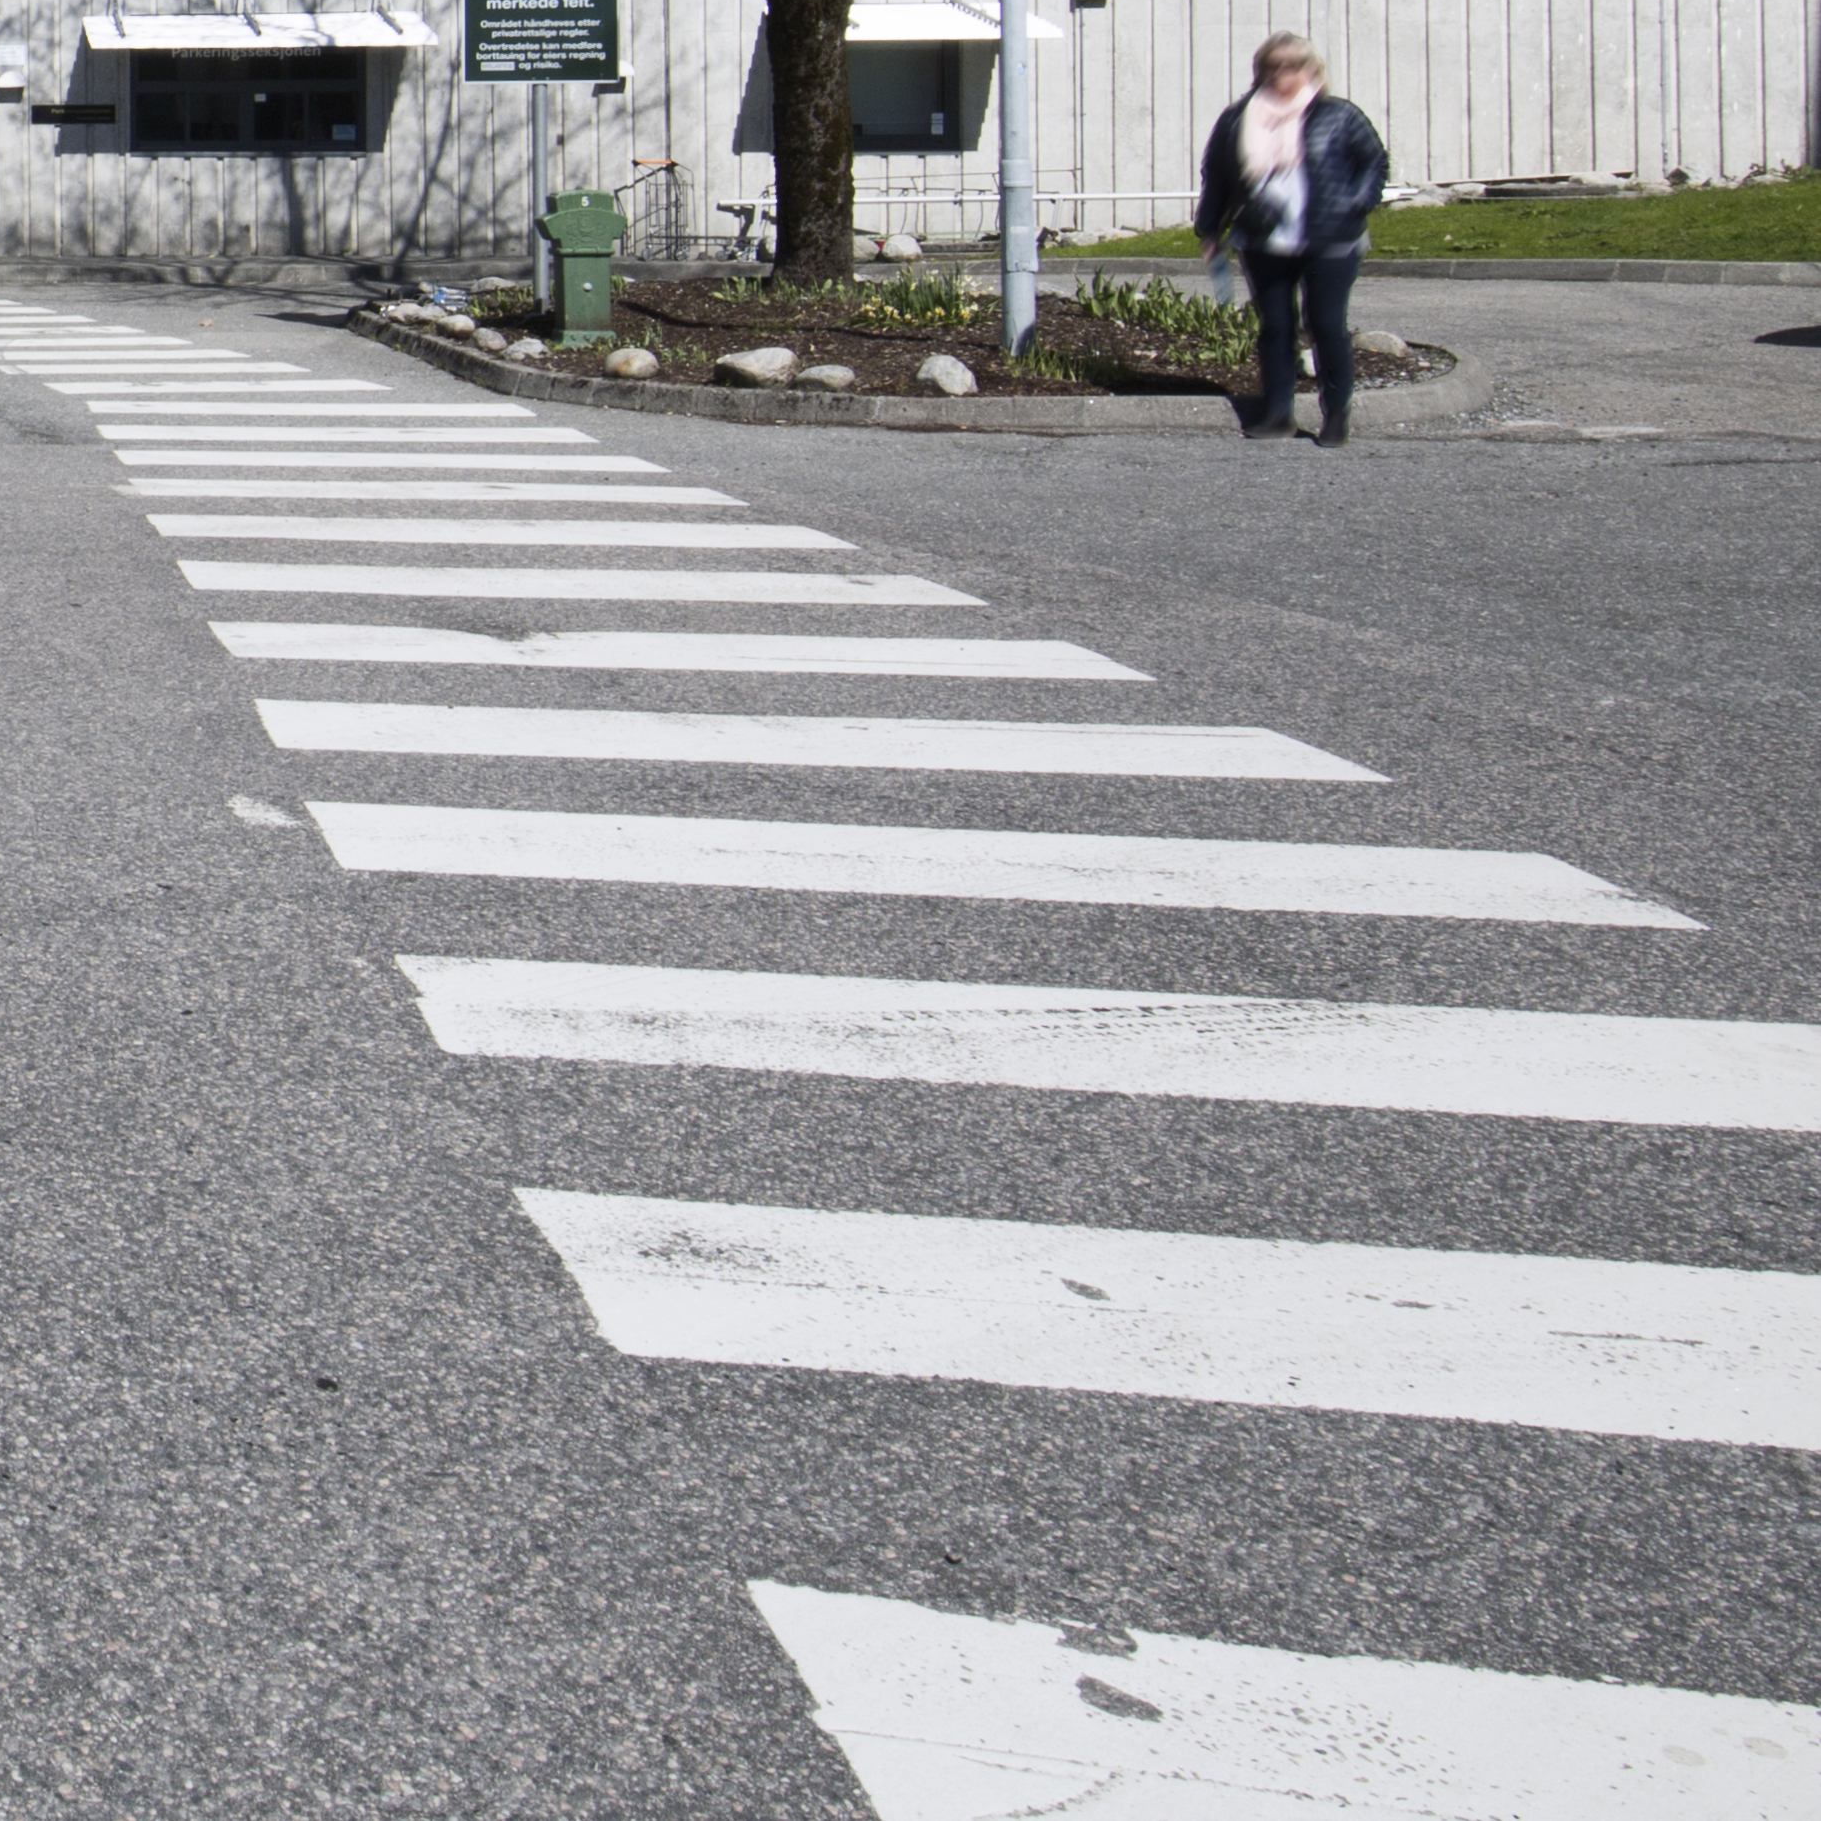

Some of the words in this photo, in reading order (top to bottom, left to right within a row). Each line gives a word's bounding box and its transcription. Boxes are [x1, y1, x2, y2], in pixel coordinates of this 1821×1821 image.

[480, 19, 522, 29] Området
[542, 42, 560, 50] kan
[171, 47, 321, 61] Parkeringsseksjonen
[581, 195, 590, 207] 5
